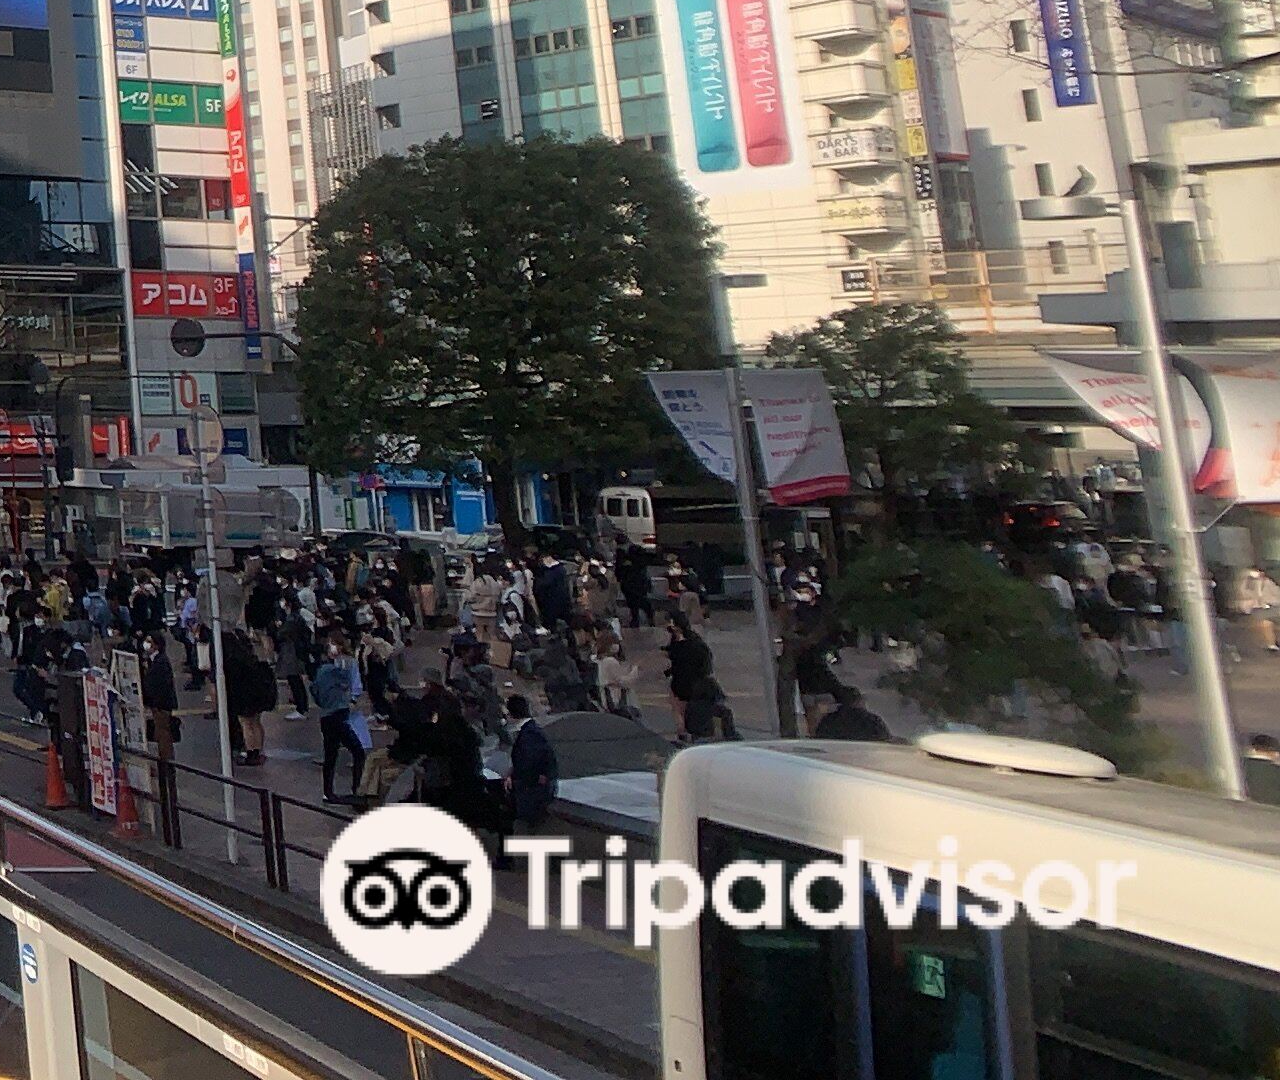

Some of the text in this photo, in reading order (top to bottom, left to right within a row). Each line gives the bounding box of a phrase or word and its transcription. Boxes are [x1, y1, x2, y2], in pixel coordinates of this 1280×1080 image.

[125, 64, 138, 75] 6F
[120, 90, 222, 113] レイク ALSA 5F
[817, 136, 859, 150] DARTS
[229, 130, 246, 174] アコム
[834, 146, 860, 158] BAR
[141, 281, 208, 307] アコム
[213, 277, 234, 294] 3F
